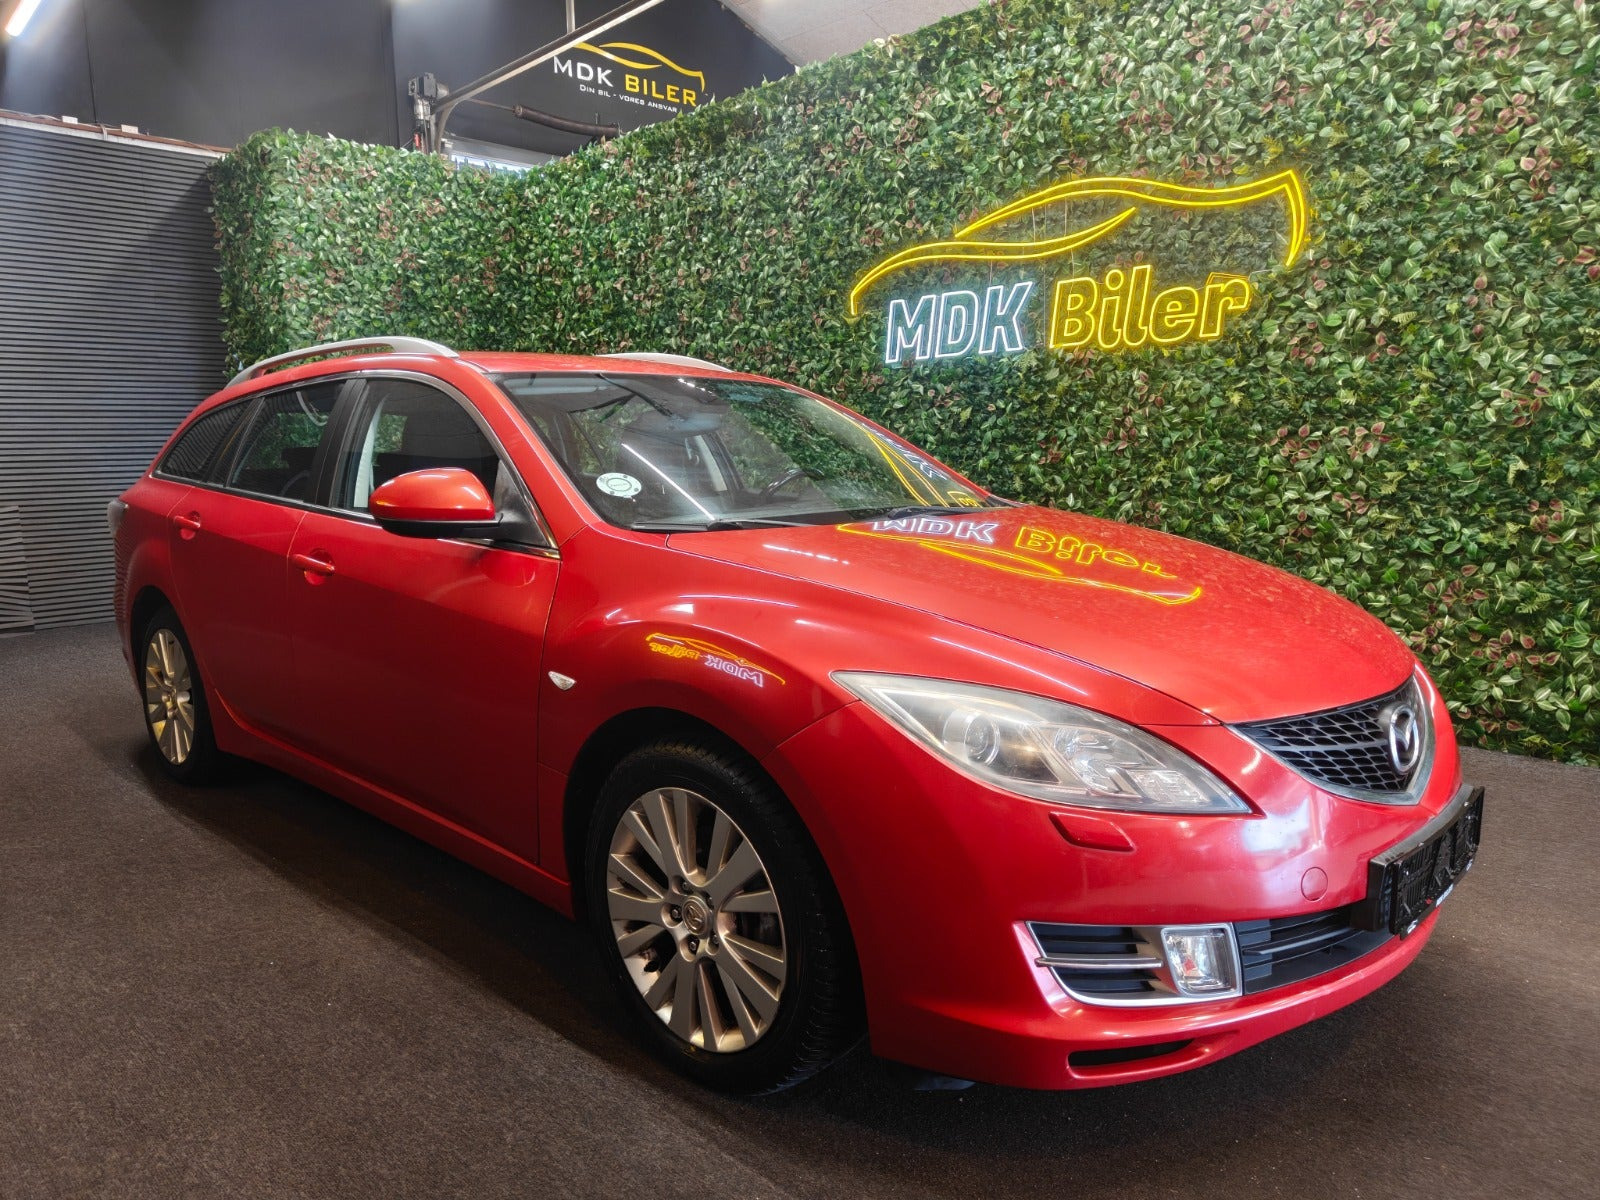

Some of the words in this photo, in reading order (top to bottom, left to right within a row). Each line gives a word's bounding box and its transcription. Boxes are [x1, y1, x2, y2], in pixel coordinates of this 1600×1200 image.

[553, 55, 613, 87] MDK
[625, 74, 696, 107] BILER
[619, 95, 645, 105] VORES
[647, 101, 678, 113] ANSVAR
[885, 281, 1034, 364] MDK
[1049, 264, 1251, 349] Biler
